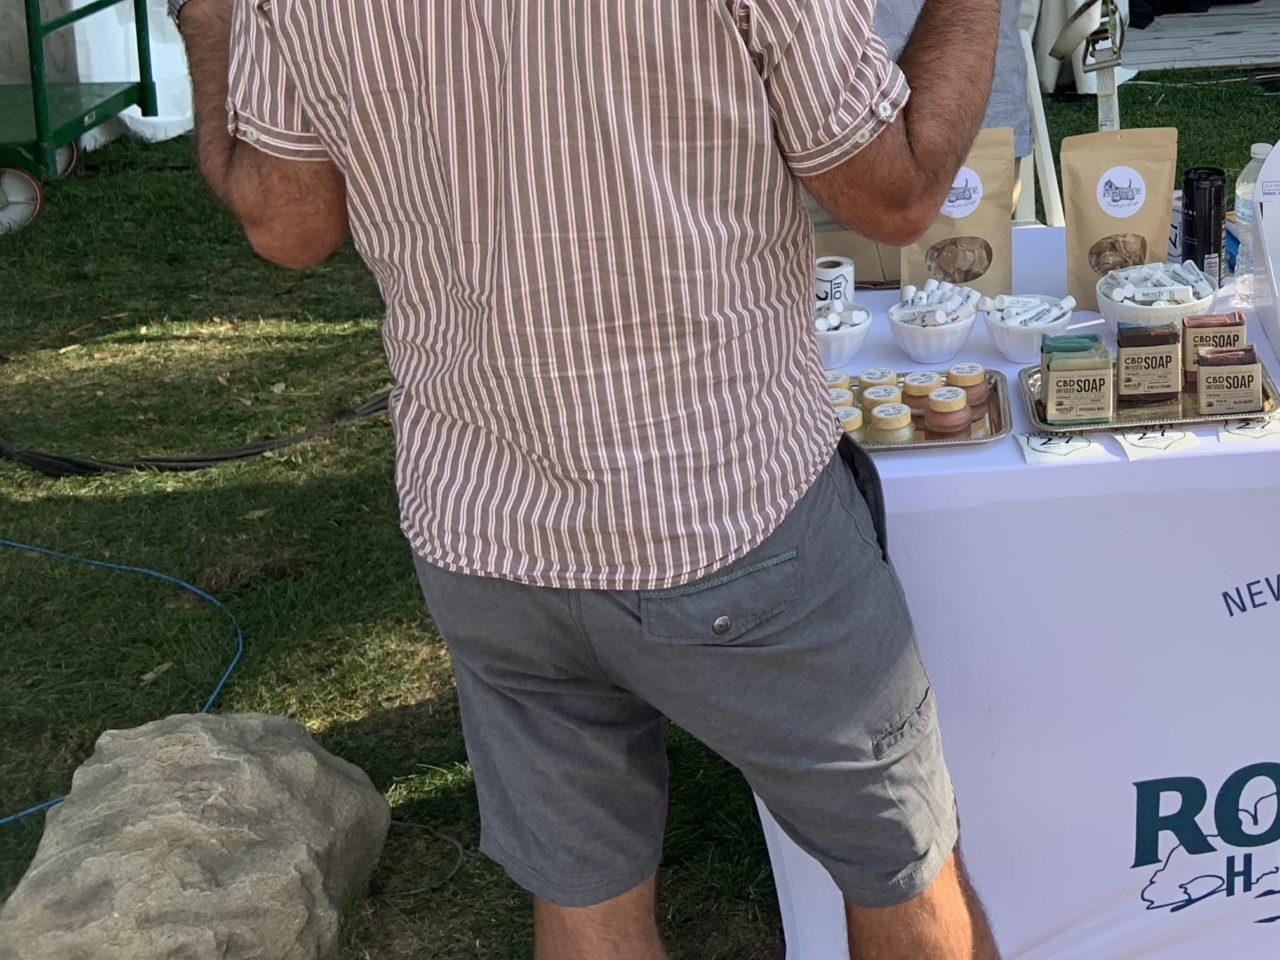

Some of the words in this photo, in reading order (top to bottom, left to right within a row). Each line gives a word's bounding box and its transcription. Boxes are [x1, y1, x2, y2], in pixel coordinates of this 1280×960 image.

[1193, 335, 1212, 343] CBD
[1212, 334, 1239, 348] SOAP
[1124, 356, 1143, 365] CBD
[1144, 355, 1172, 370] SOAP
[1056, 379, 1076, 388] CBD
[1076, 378, 1106, 393] SOAP
[1206, 376, 1225, 384] CBD
[1225, 375, 1254, 390] SOAP
